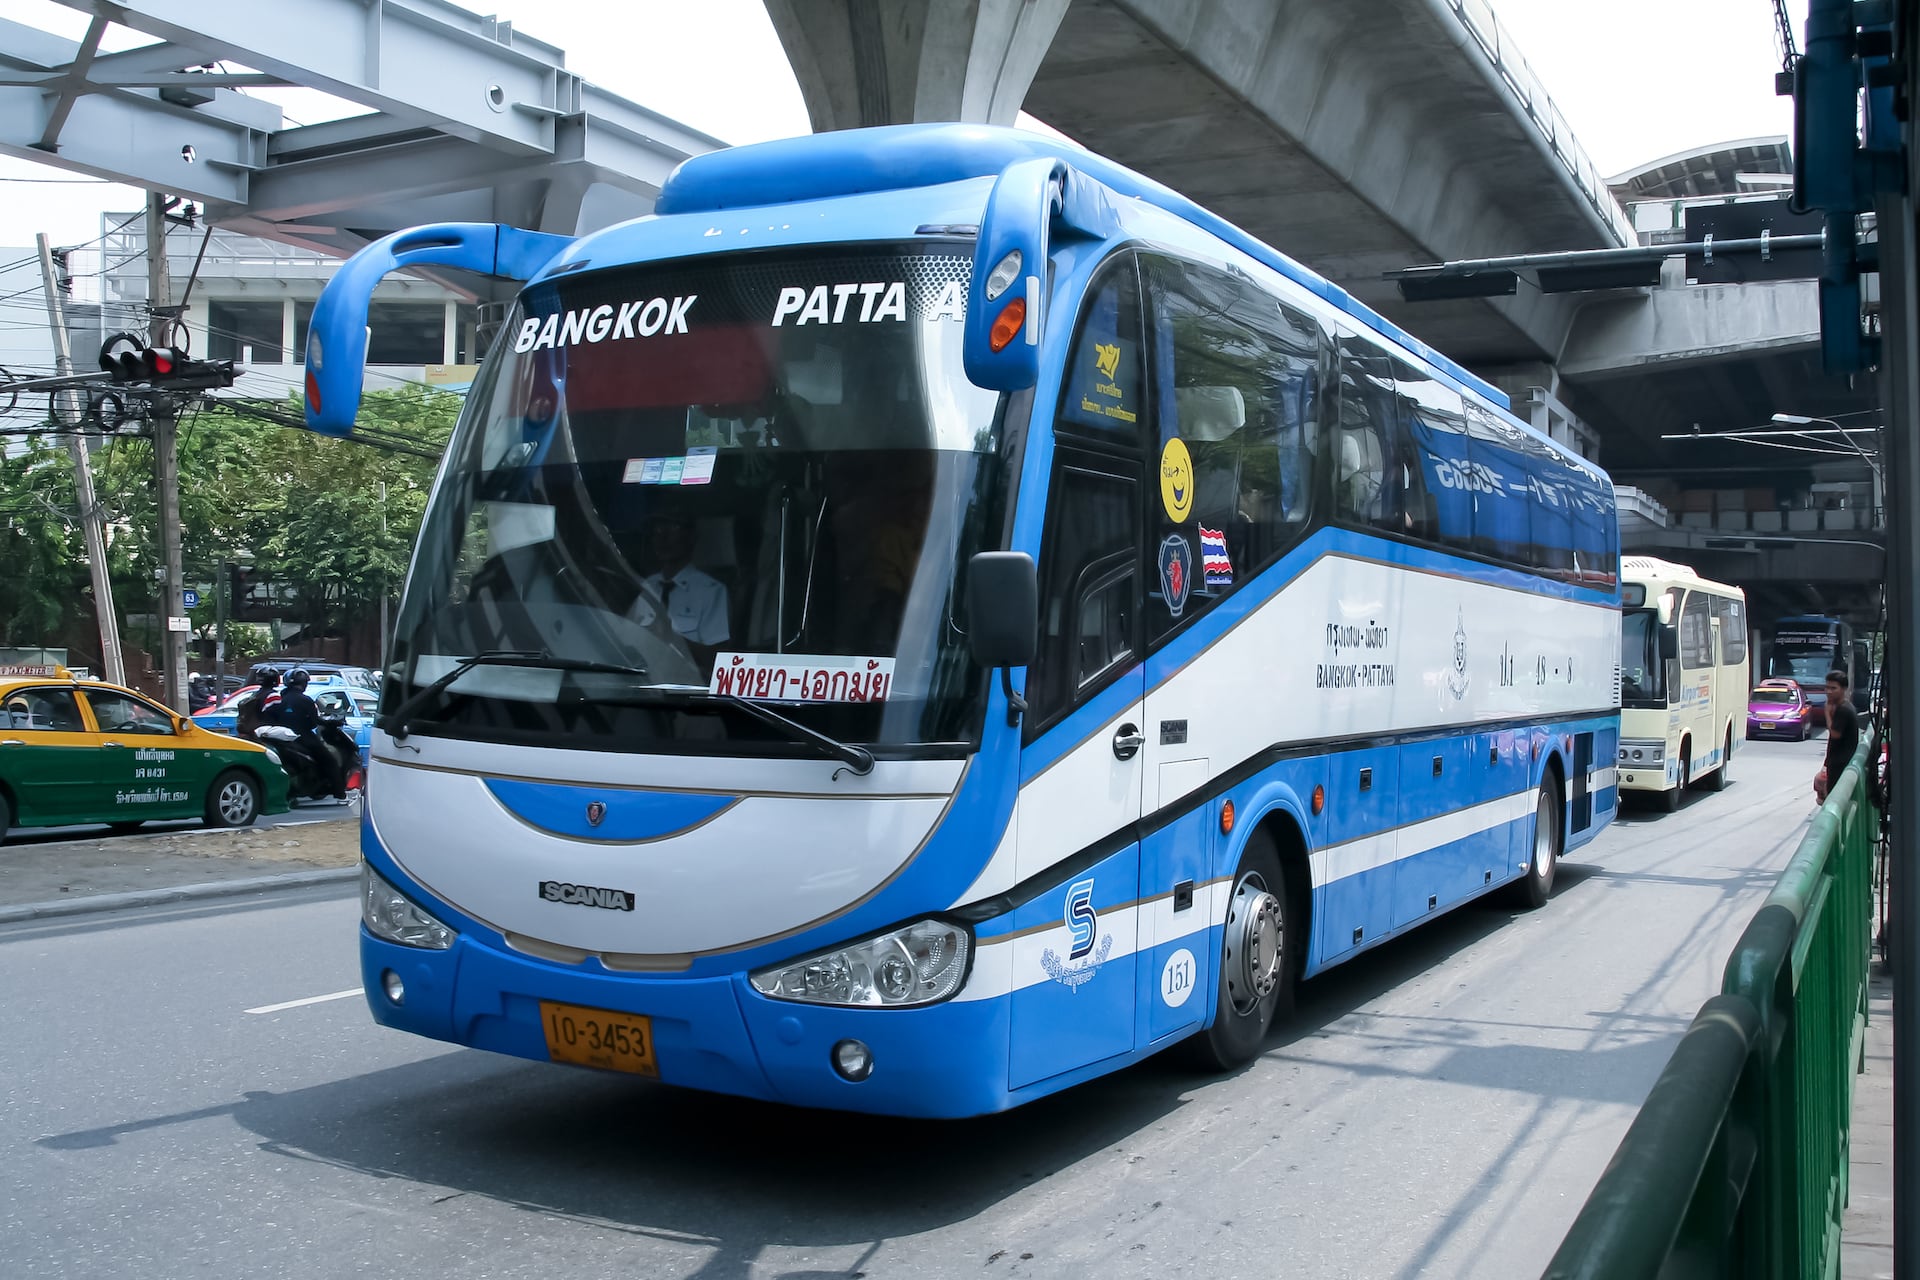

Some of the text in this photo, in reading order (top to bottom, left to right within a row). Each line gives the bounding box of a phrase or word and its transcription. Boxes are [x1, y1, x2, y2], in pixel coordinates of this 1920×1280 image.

[514, 295, 698, 354] BANGKOK
[1326, 619, 1389, 657] กรุงเทพ-พัทยา
[715, 655, 891, 702] พัทยา-เอกมัย
[1316, 663, 1395, 689] BANGKOK-PATTAYA
[544, 882, 629, 910] SCANIA
[1167, 959, 1190, 995] 151
[551, 1014, 646, 1057] 10-3453
